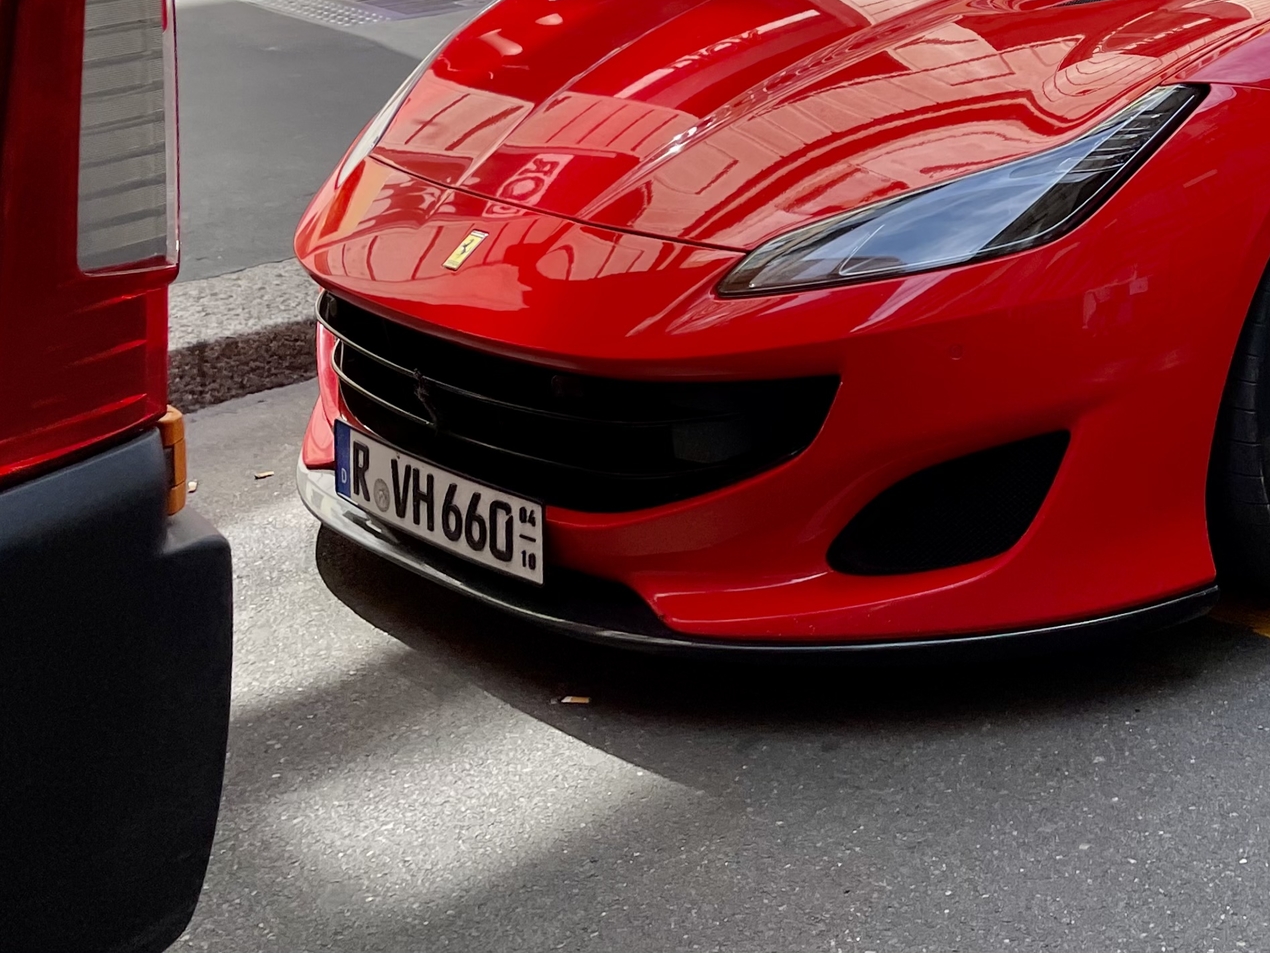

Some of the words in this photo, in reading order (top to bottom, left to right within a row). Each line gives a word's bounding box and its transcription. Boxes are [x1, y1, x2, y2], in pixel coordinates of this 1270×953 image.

[341, 468, 348, 484] D
[353, 439, 371, 502] R
[391, 458, 435, 532] VH
[442, 482, 514, 563] 660
[519, 506, 536, 528] 04
[520, 549, 536, 571] 10
